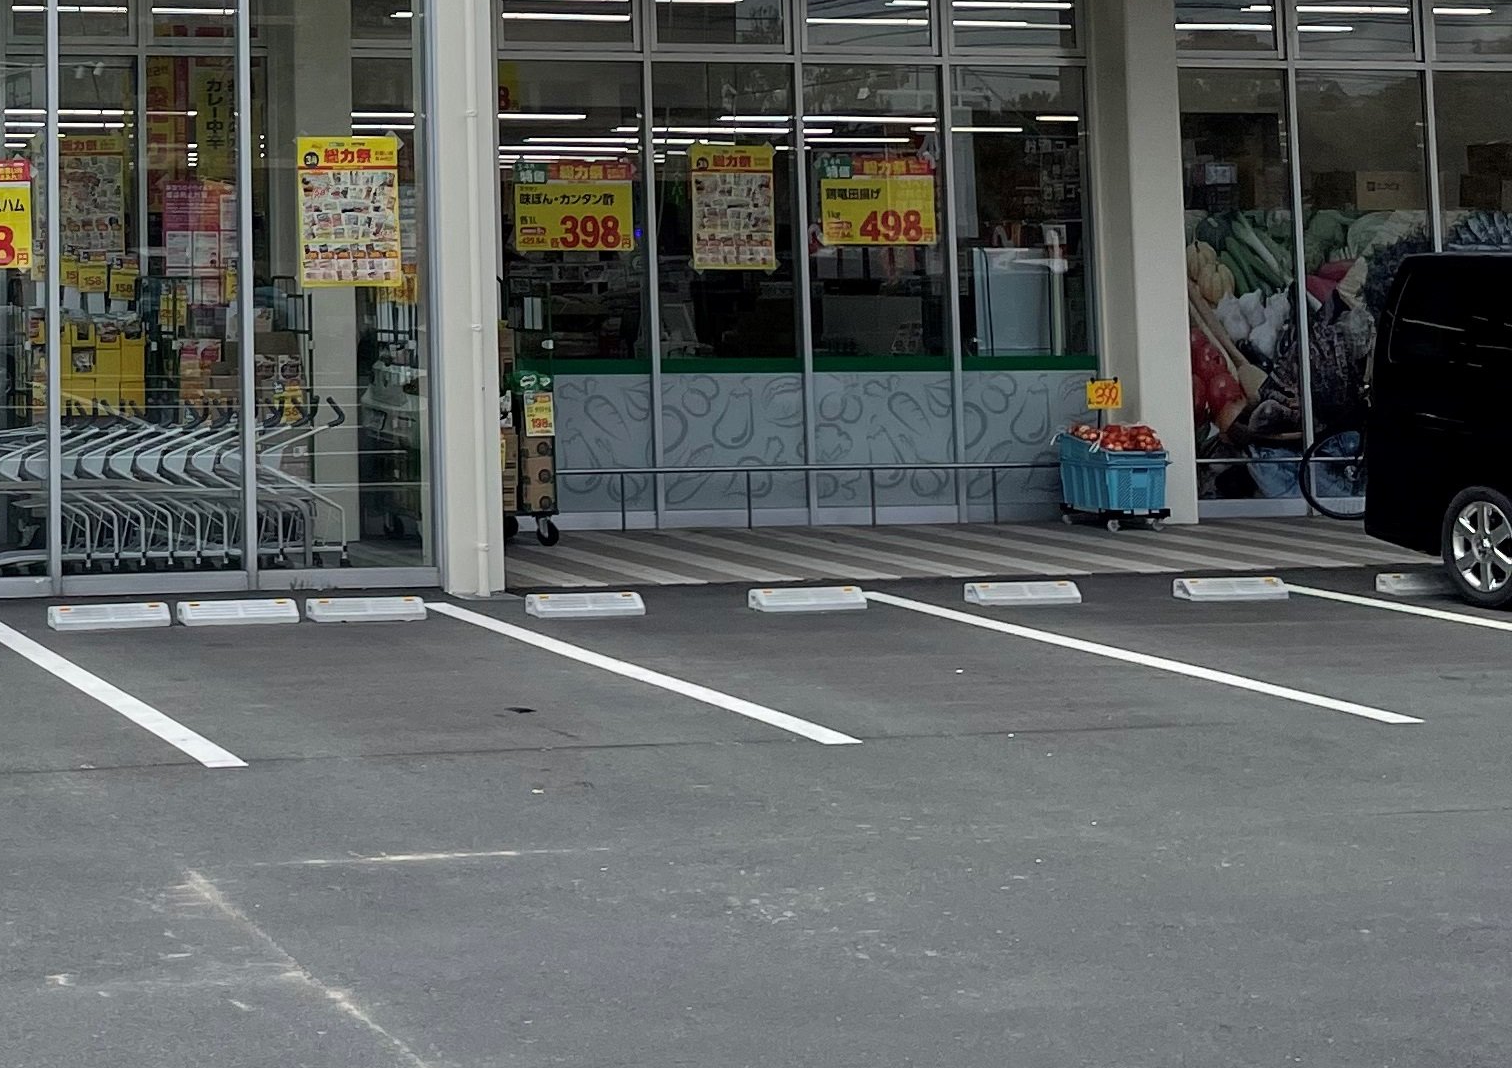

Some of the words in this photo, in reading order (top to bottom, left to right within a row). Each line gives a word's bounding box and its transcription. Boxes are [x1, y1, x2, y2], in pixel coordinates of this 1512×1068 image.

[324, 148, 372, 164] 総力祭
[559, 215, 621, 249] 398
[859, 210, 924, 242] 498
